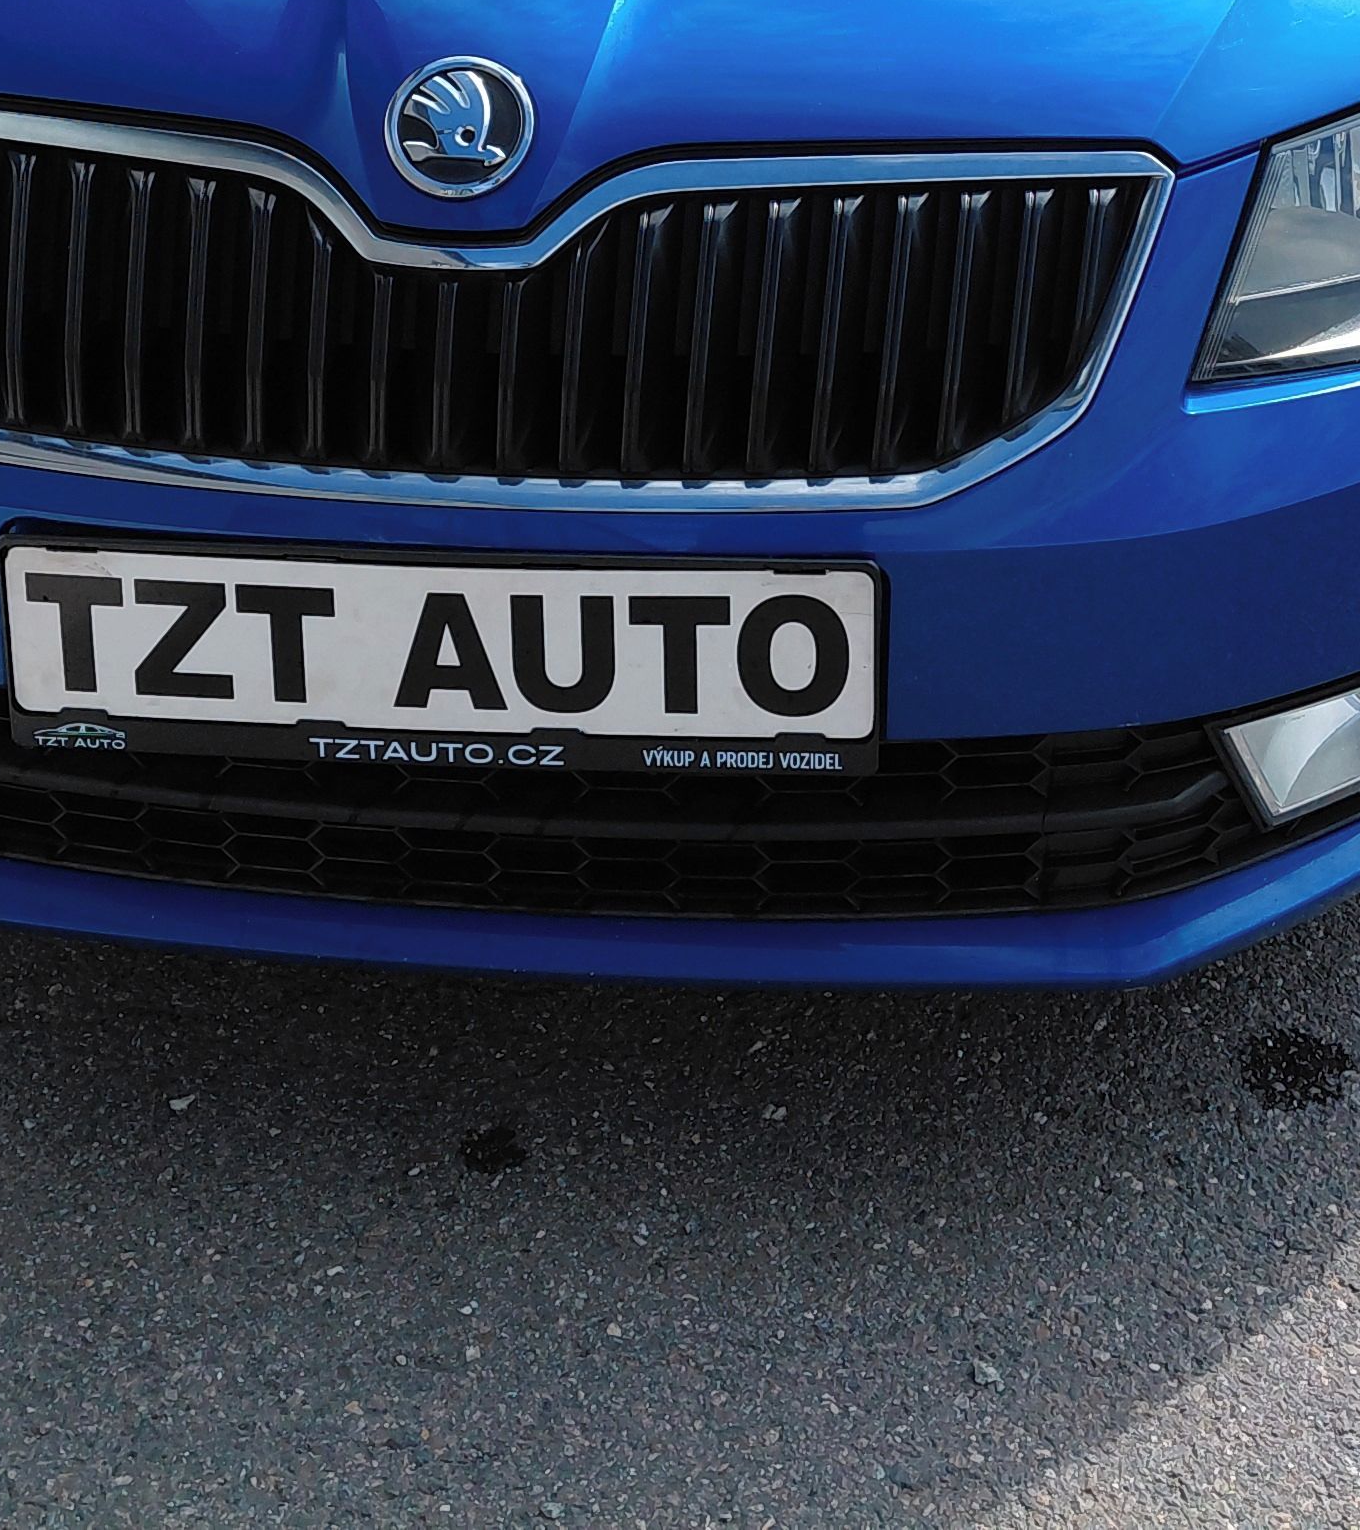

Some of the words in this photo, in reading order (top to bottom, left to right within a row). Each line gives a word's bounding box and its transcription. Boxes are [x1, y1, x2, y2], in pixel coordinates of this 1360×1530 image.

[25, 572, 336, 703] TZT
[393, 591, 850, 717] AUTO
[34, 735, 69, 747] TZT
[74, 738, 126, 750] AUTO
[308, 737, 565, 766] TZTAUTO.CZ
[642, 745, 695, 767] VÝKUP
[699, 750, 711, 768] A
[716, 751, 774, 769] PRODEJ
[778, 752, 843, 770] VOZIDEL
